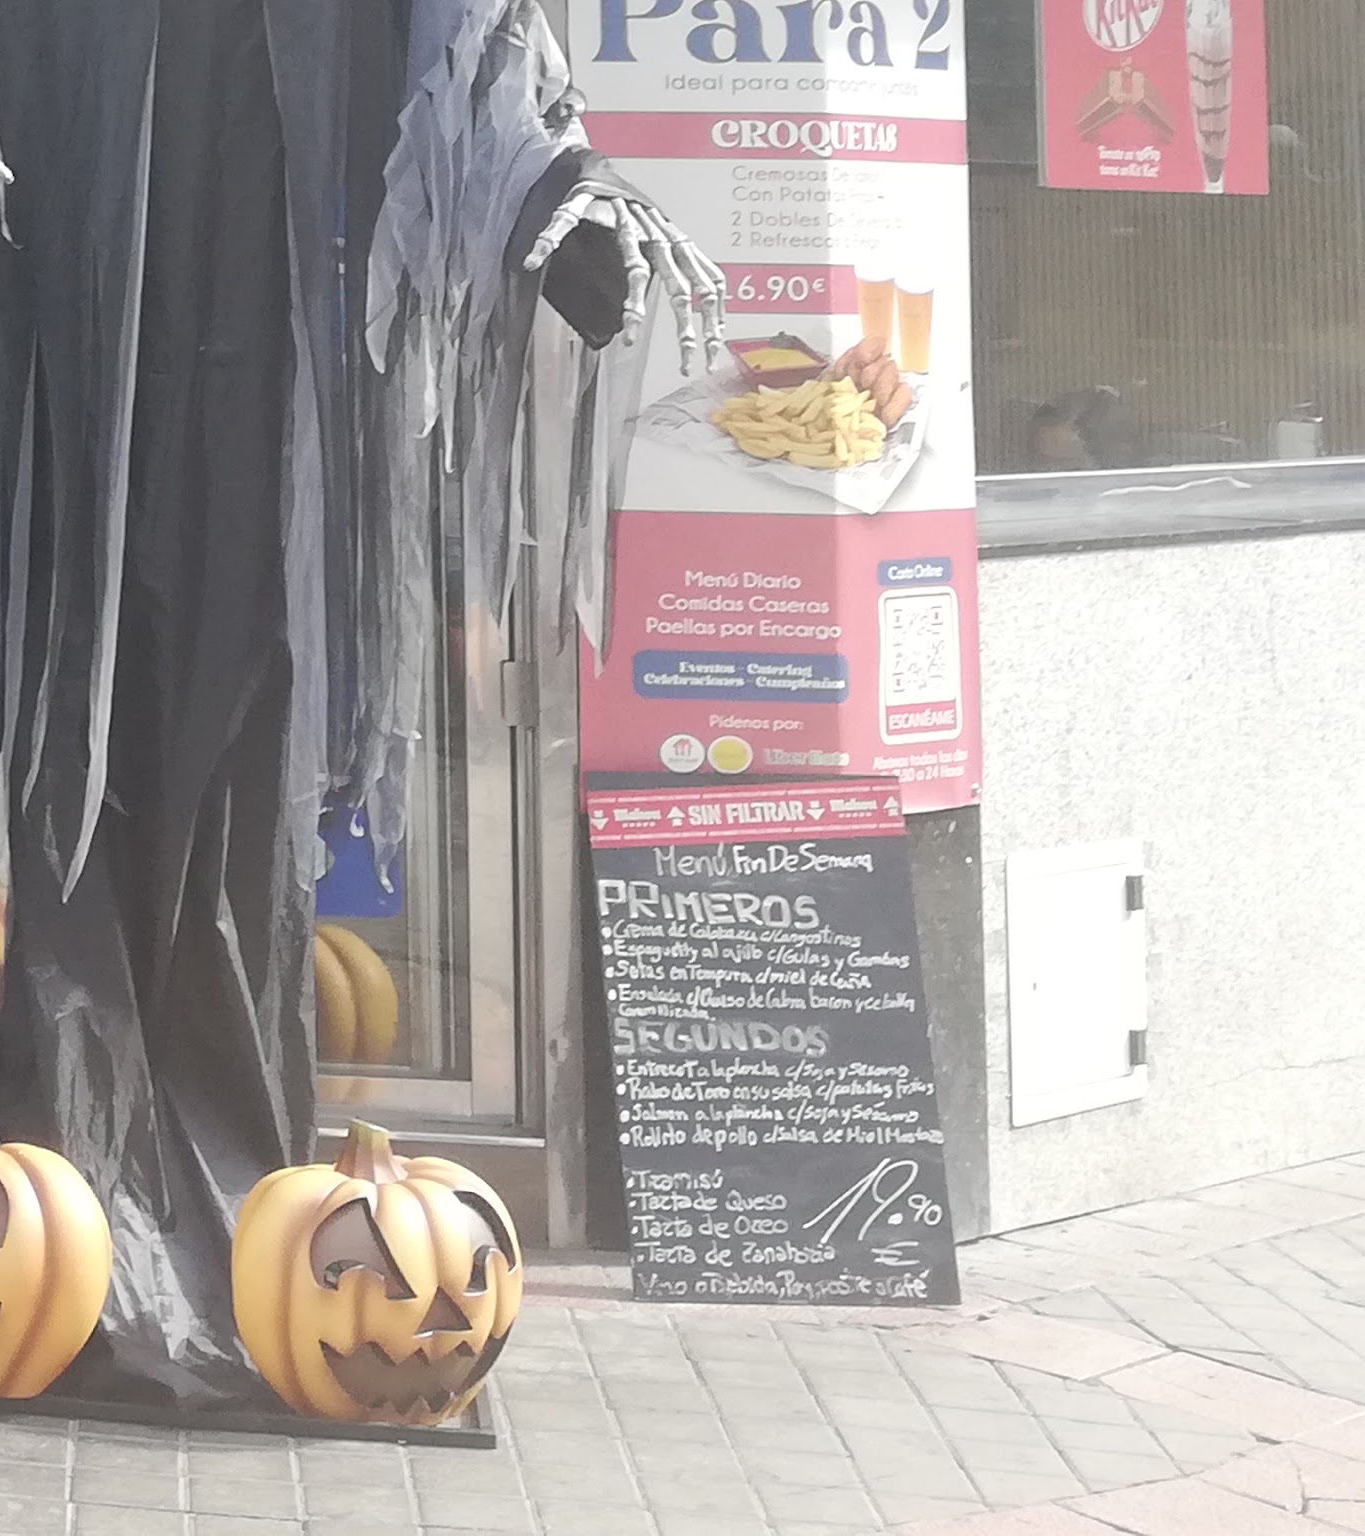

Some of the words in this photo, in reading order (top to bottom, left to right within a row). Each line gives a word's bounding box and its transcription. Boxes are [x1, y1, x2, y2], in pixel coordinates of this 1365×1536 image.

[665, 75, 724, 91] Ideal
[732, 77, 790, 96] para
[711, 119, 898, 158] CROQUETAS
[731, 165, 828, 183] Cremosas
[731, 185, 773, 202] Con
[730, 211, 742, 227] 2
[750, 212, 821, 228] Dobles
[730, 231, 742, 248] 2
[725, 274, 826, 302] 6.90€
[685, 570, 738, 589] Menú
[743, 571, 802, 590] Diario
[658, 593, 744, 612] Comidas
[748, 595, 830, 614] Caseras
[645, 616, 716, 636] Paellas
[720, 622, 754, 638] por
[759, 620, 842, 641] Encargo
[687, 805, 722, 825] SIN
[725, 801, 806, 824] FILTRAR
[653, 842, 727, 877] Menú
[732, 845, 768, 875] Fin
[767, 844, 800, 873] De
[597, 879, 820, 930] PRIMEROS
[613, 1016, 830, 1059] SEGUNDOS
[724, 1189, 788, 1213] Queso
[698, 1213, 731, 1239] de
[704, 1239, 734, 1268] de
